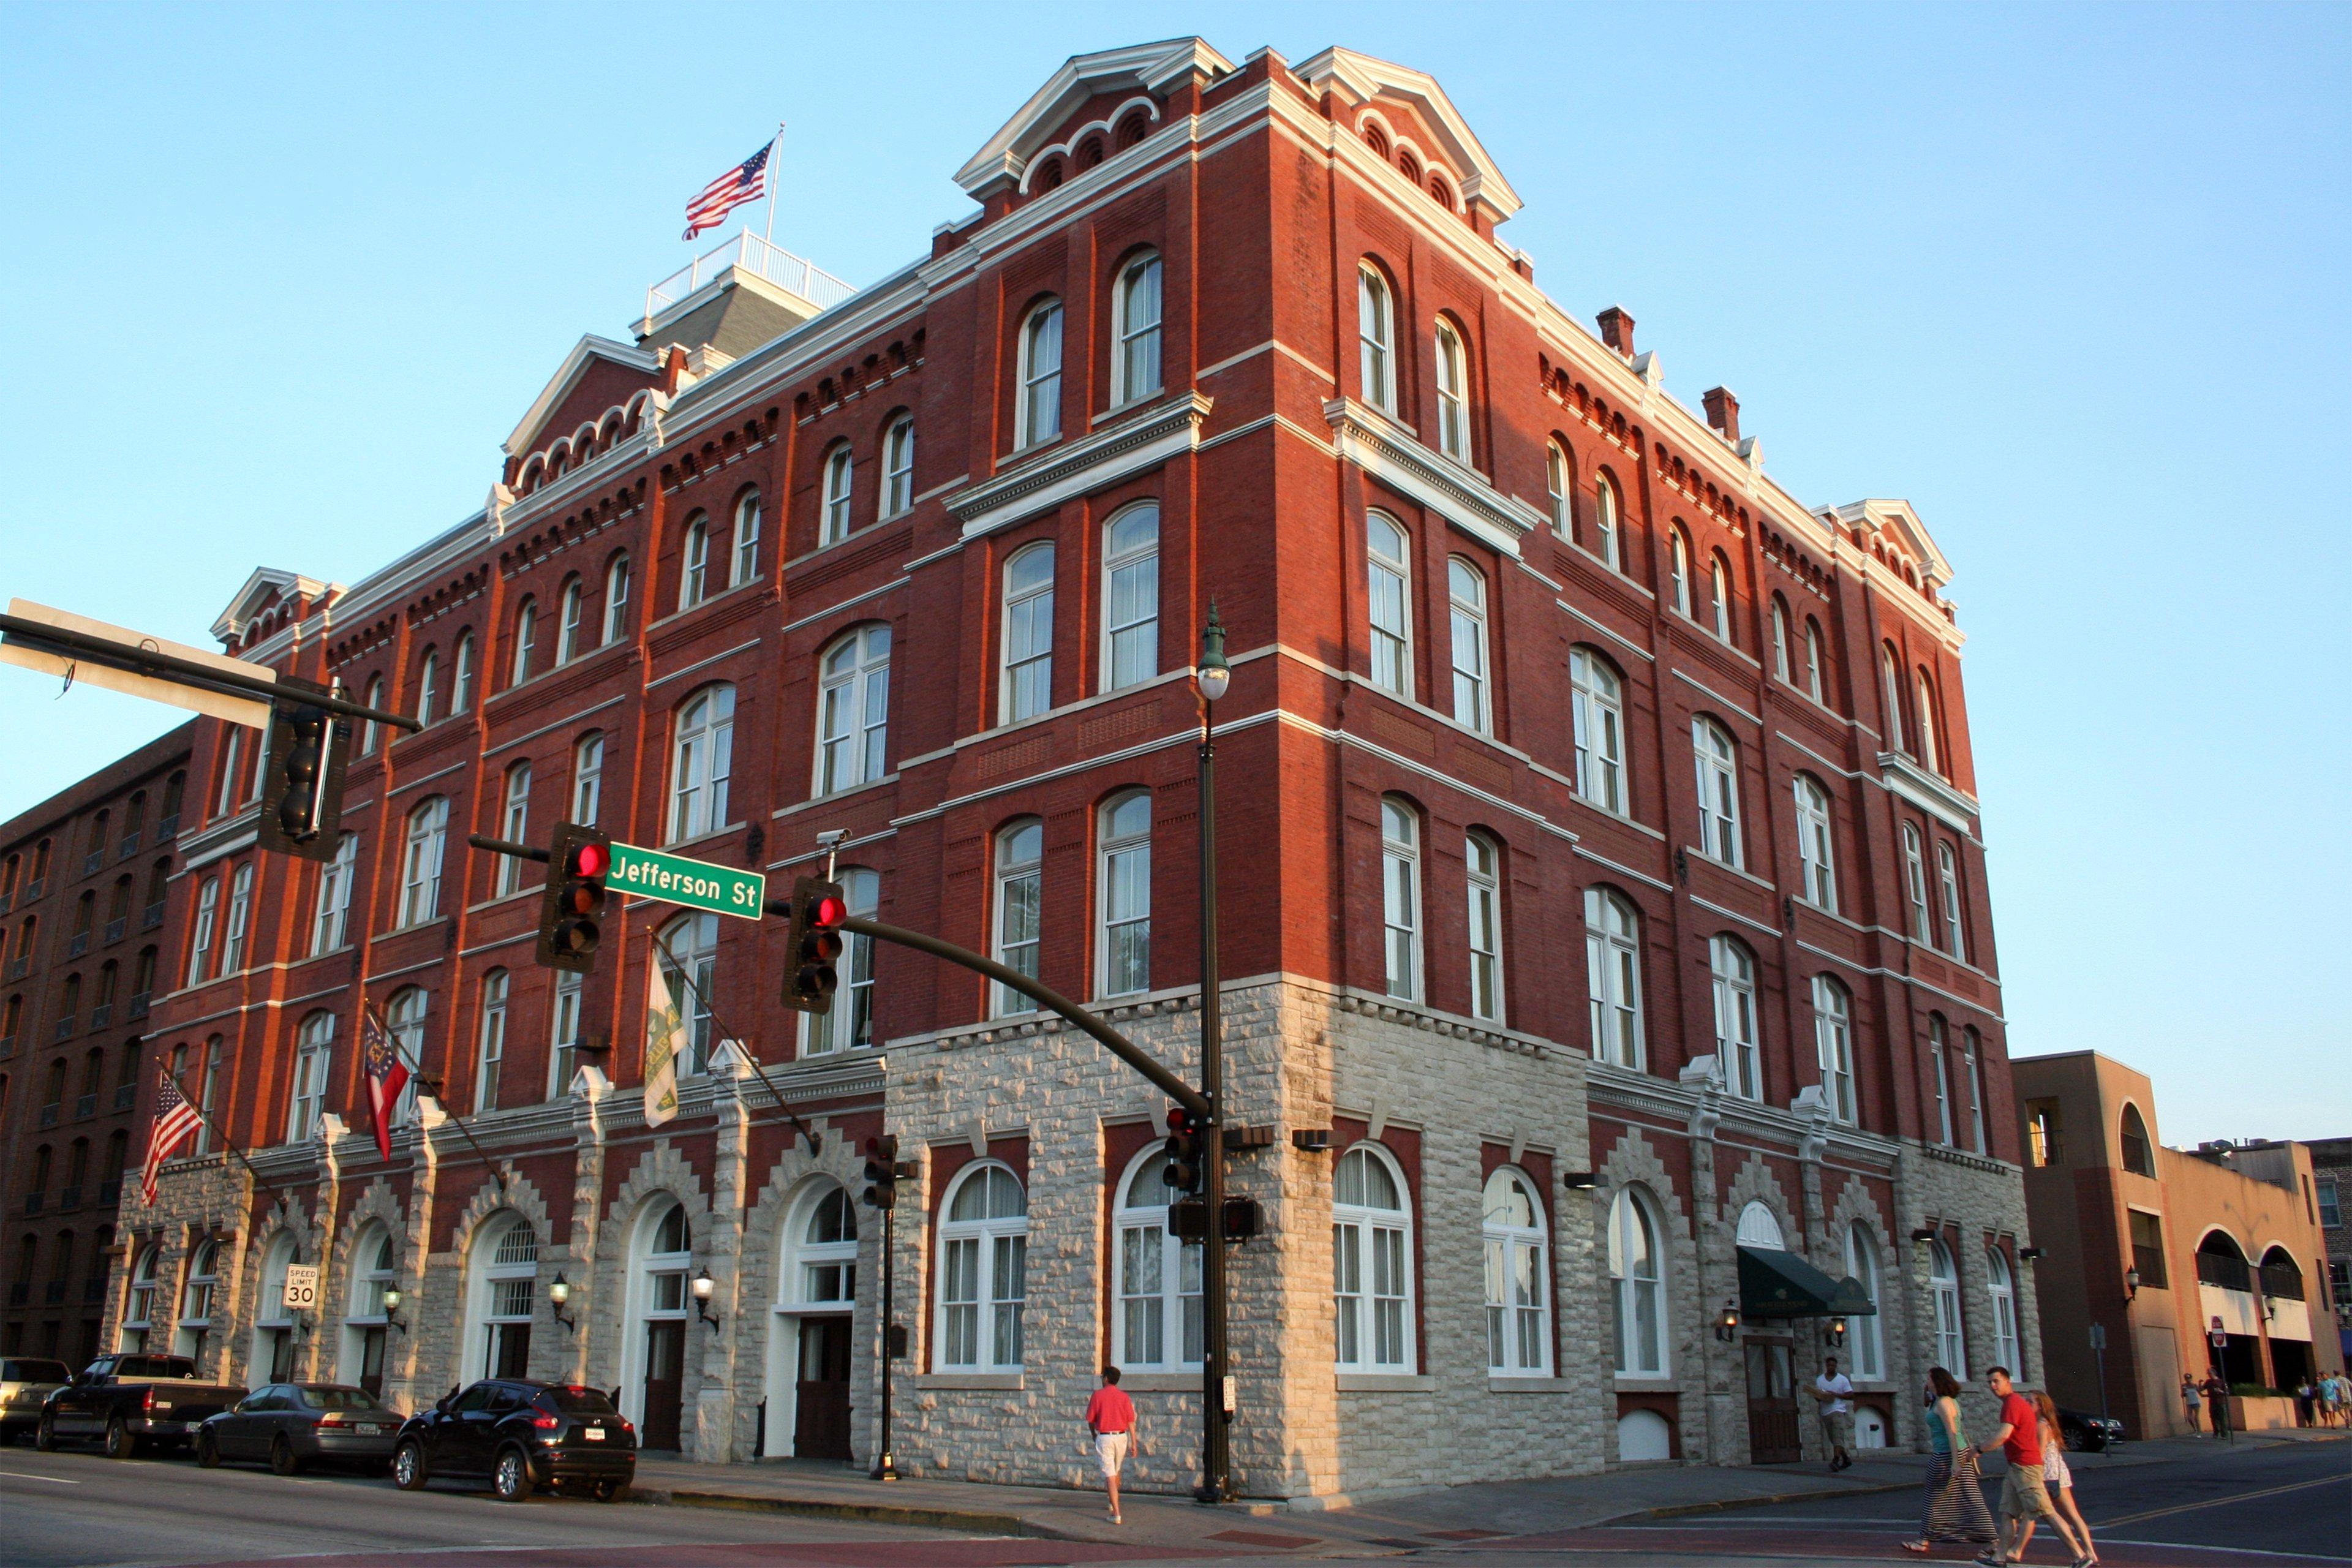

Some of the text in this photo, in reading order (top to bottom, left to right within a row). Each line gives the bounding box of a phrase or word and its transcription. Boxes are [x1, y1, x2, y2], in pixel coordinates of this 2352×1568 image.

[612, 857, 756, 907] Jefferson St
[288, 1287, 312, 1302] 30
